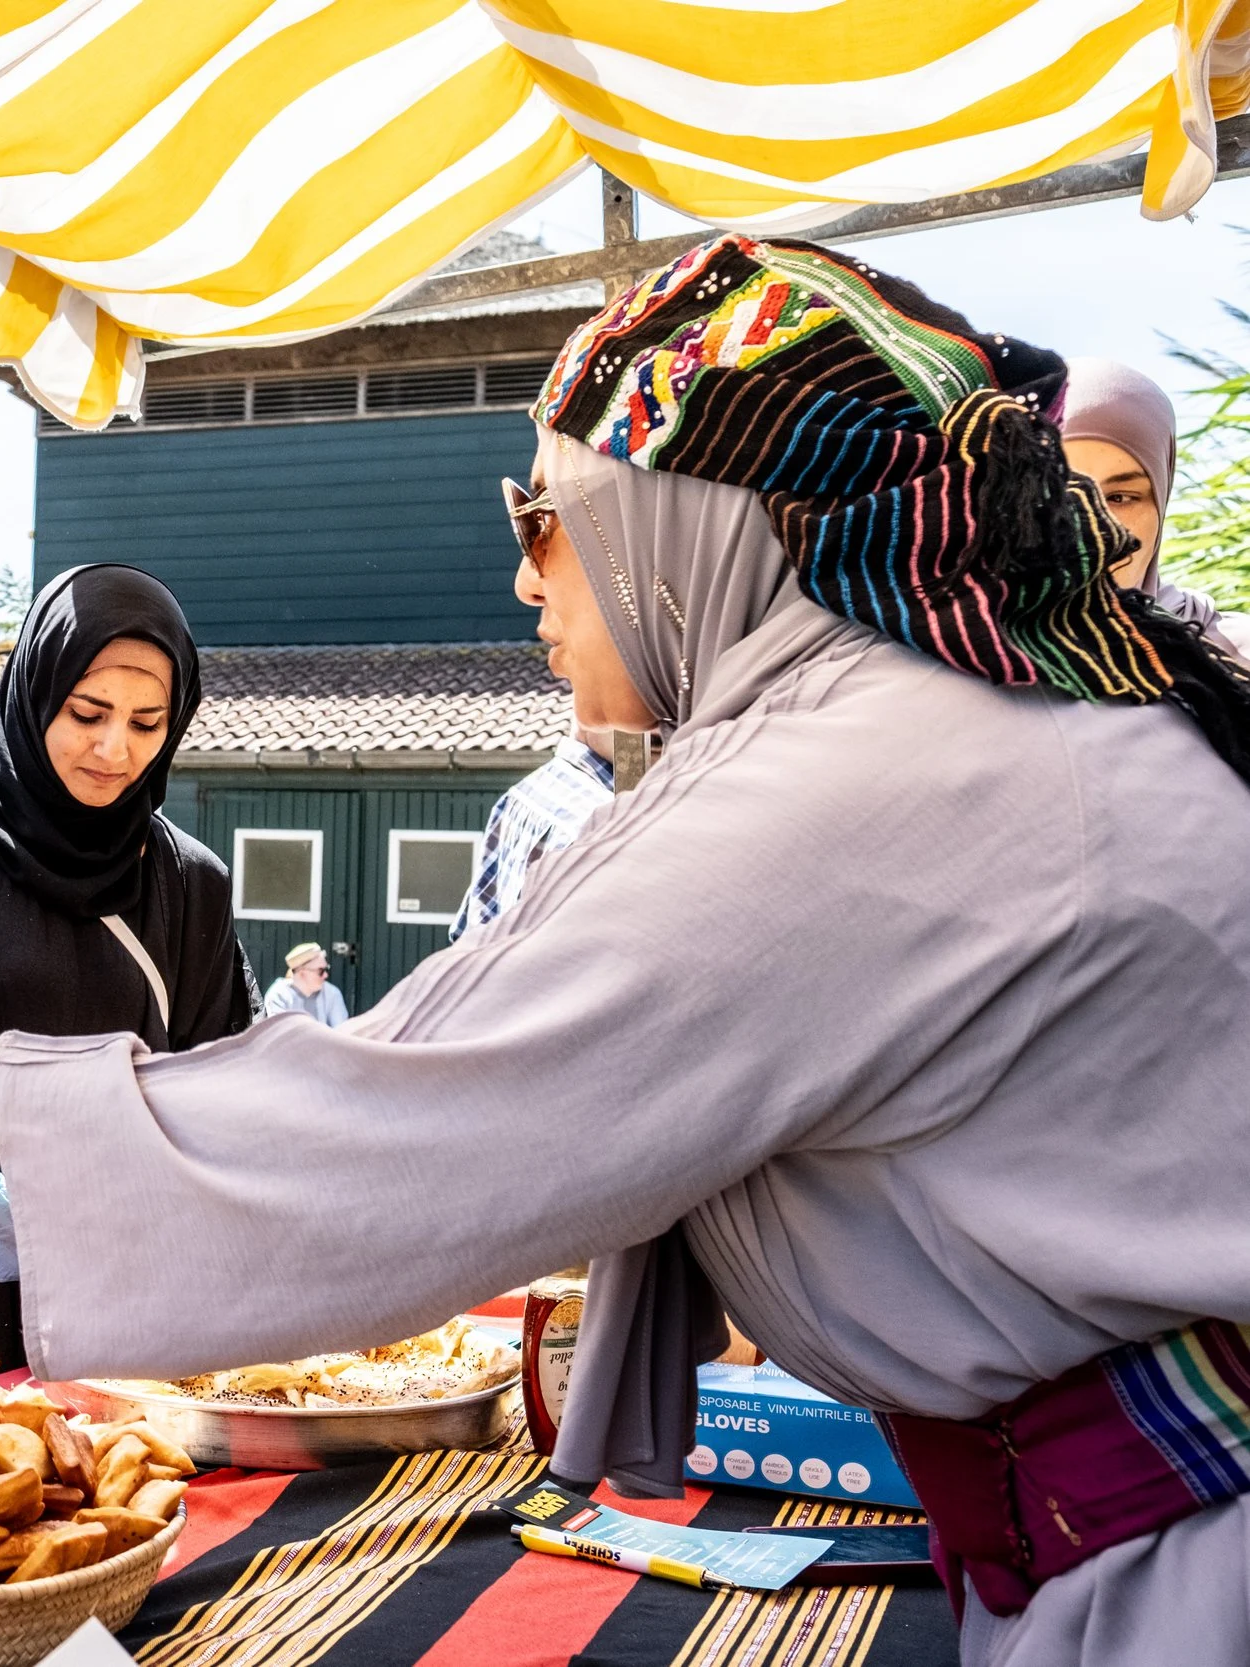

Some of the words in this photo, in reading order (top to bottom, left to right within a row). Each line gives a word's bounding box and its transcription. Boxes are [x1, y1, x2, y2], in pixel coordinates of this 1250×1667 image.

[700, 1396, 761, 1412] SPOSABLE
[767, 1403, 852, 1422] VINYL/NITRILE
[514, 1489, 556, 1515] BLOCK
[530, 1493, 570, 1520] PARTY
